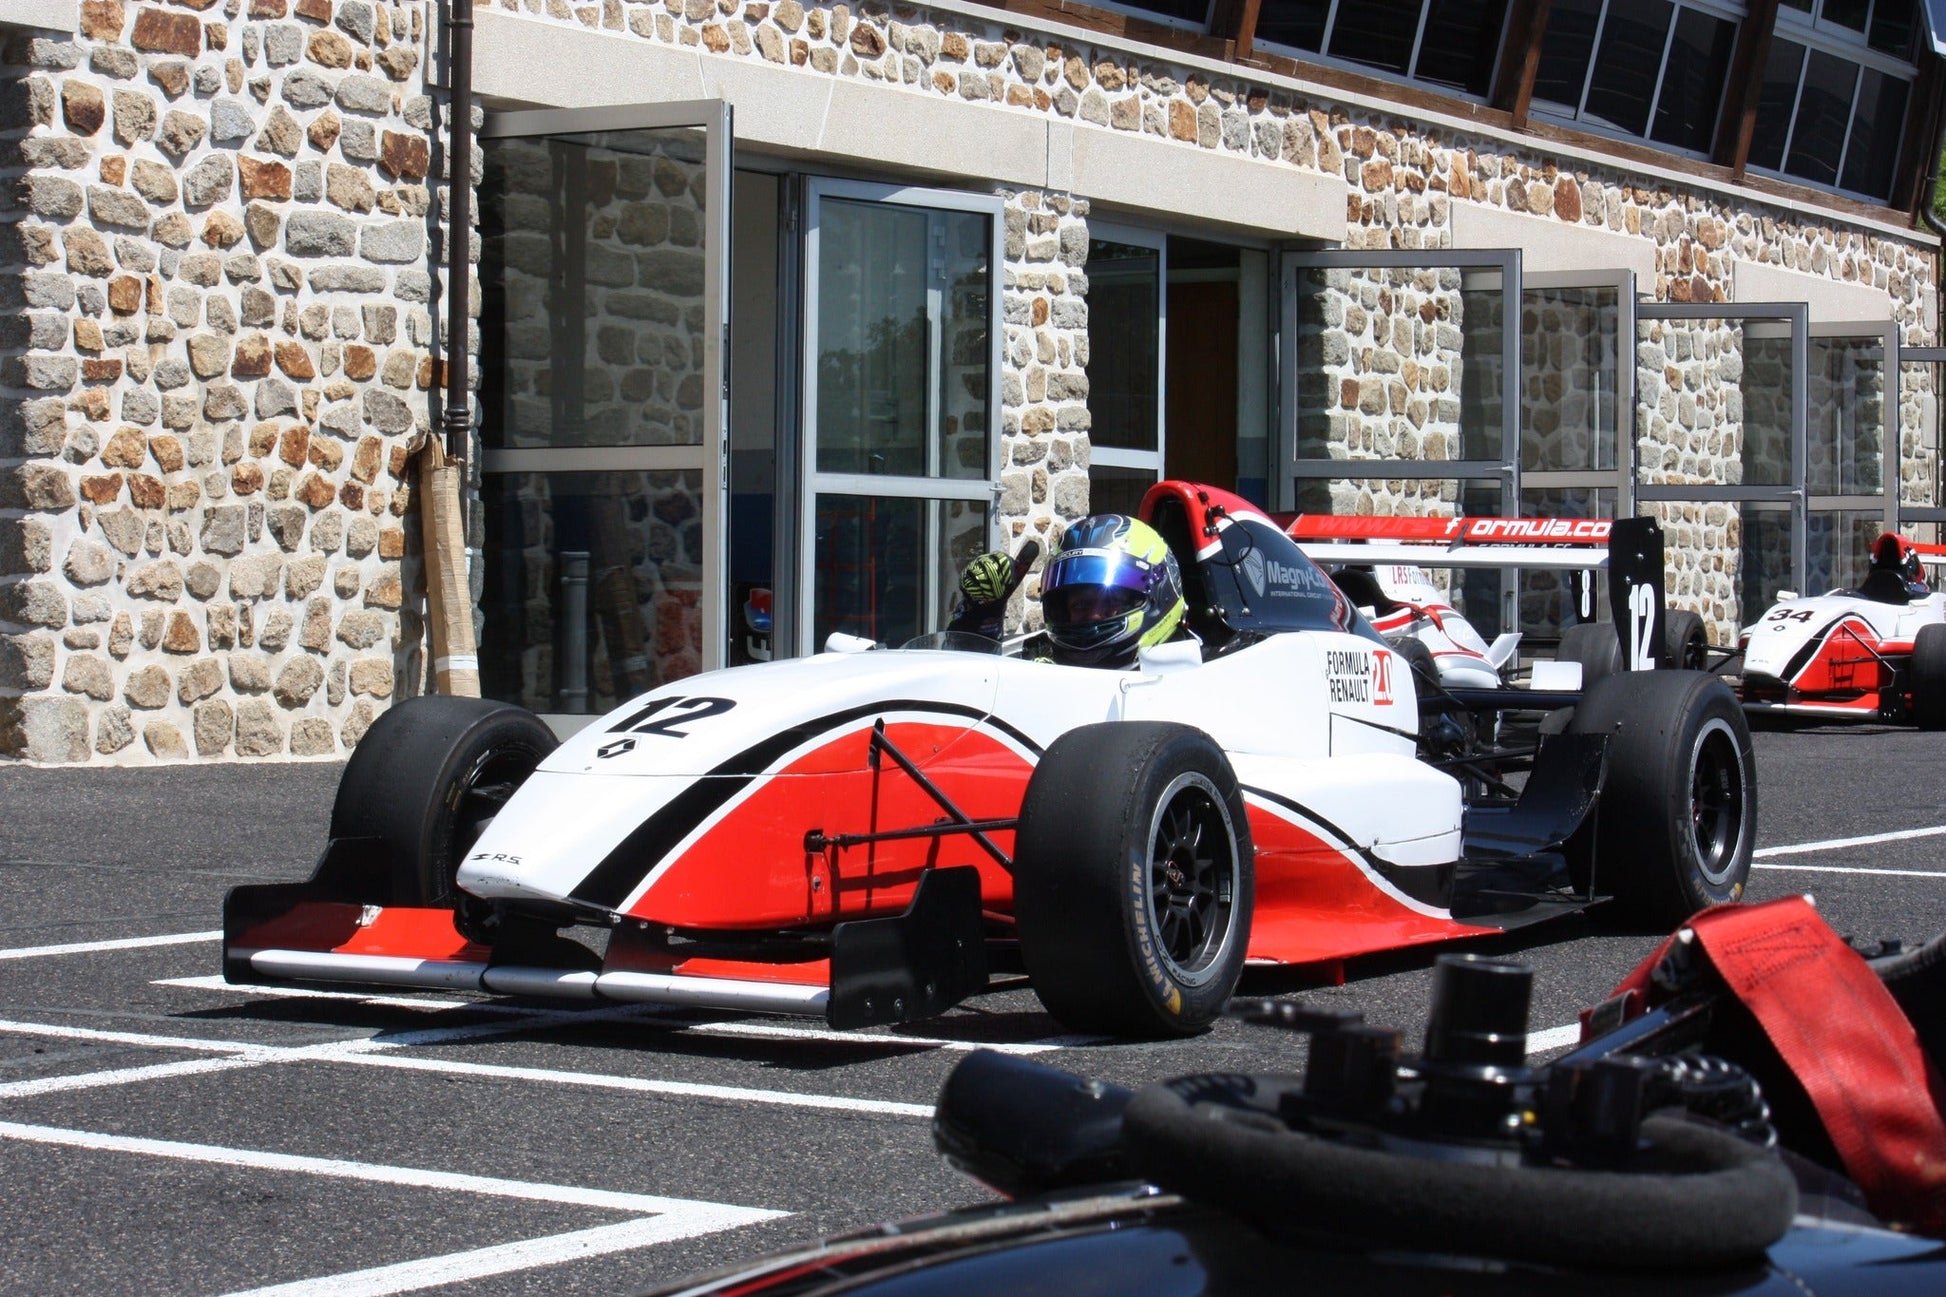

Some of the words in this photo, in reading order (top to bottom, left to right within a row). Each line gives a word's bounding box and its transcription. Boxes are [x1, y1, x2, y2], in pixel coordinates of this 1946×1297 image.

[1581, 569, 1591, 618] 8
[1628, 583, 1656, 671] 12
[1767, 609, 1815, 623] 34
[1327, 651, 1370, 675] FORMULA
[1330, 679, 1369, 702] RENAULT
[604, 696, 738, 739] 12
[1132, 863, 1164, 984] MICHELIN
